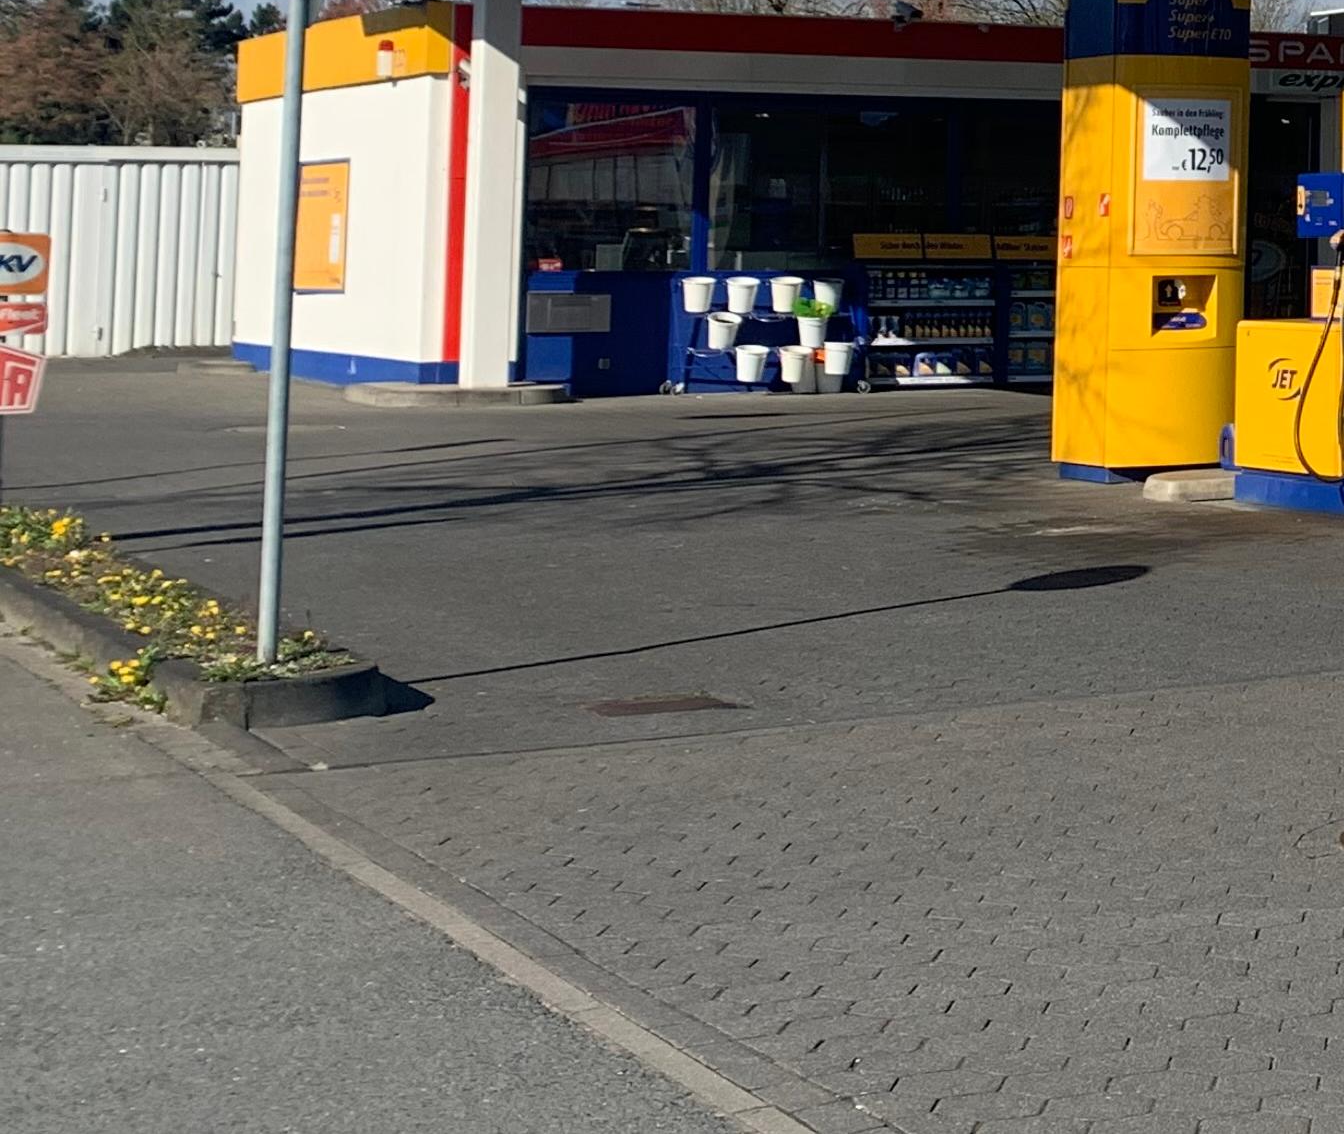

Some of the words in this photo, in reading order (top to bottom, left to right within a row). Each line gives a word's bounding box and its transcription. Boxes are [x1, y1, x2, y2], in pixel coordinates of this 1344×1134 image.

[1168, 26, 1209, 43] Super
[1211, 28, 1232, 41] E10
[1152, 123, 1225, 140] Komplettpflege
[1272, 369, 1298, 389] JET
